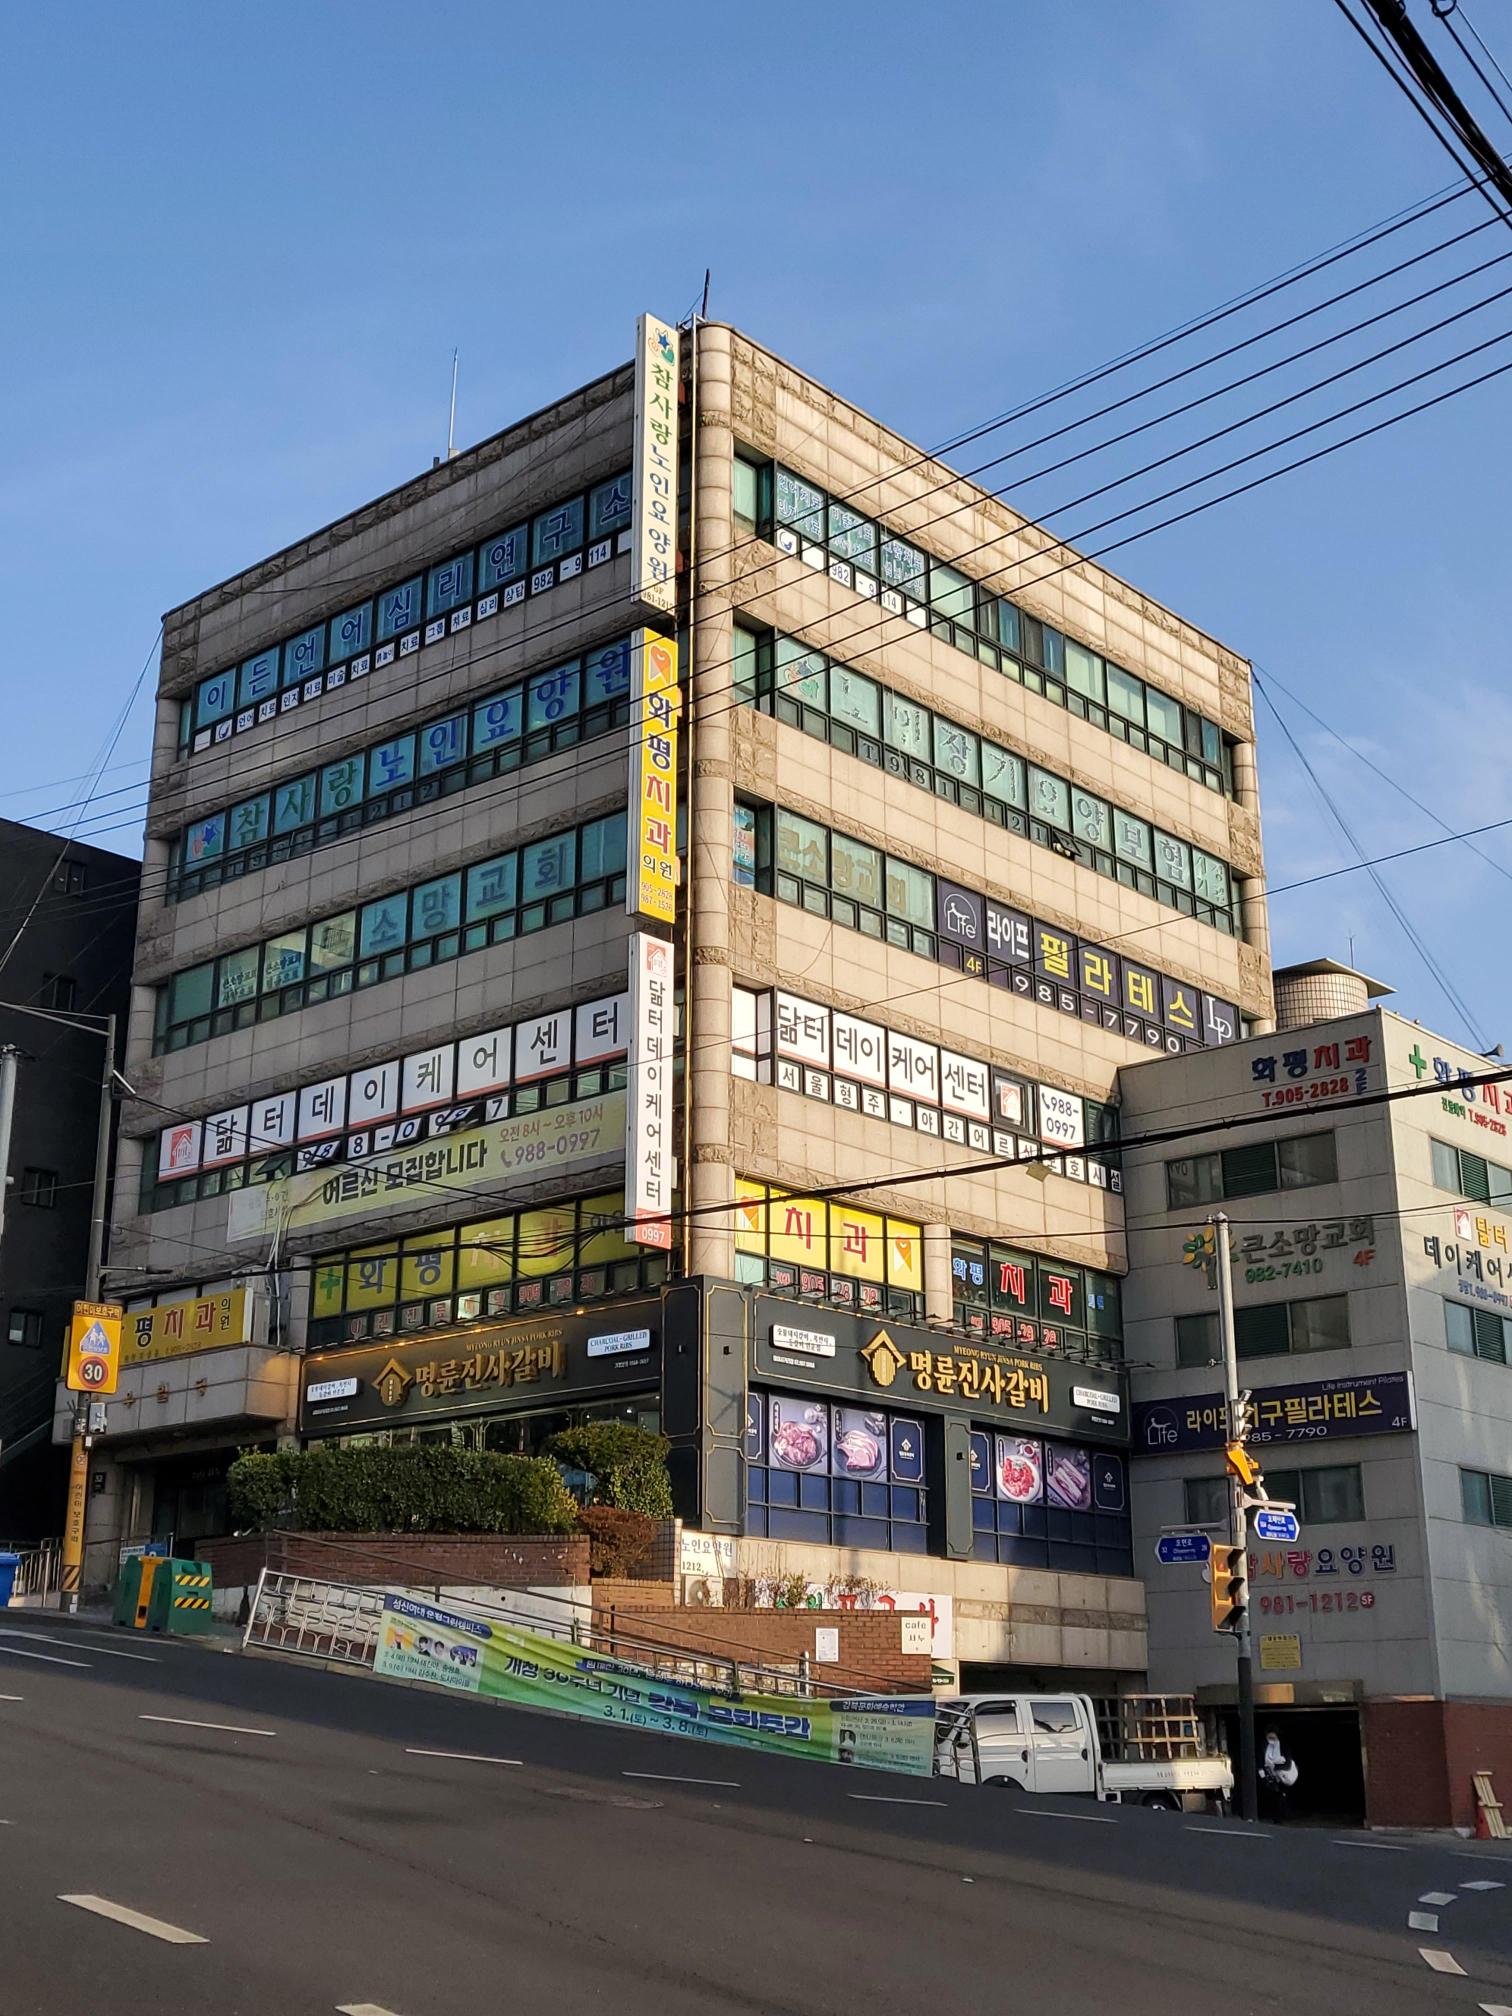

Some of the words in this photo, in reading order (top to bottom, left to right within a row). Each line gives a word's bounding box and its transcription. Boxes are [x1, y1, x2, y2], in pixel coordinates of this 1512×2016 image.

[647, 364, 673, 586] 참사랑노인요양원
[239, 700, 275, 728] 언어치료
[283, 680, 320, 708] 인지치료
[329, 659, 368, 686] 미술치료
[534, 545, 607, 591] 982-9114
[646, 690, 672, 855] 화평치과
[643, 854, 672, 881] 의원
[370, 842, 567, 951] 소망교회
[966, 958, 983, 974] 4F
[988, 909, 1030, 960] 라이프
[1040, 931, 1194, 1030] 필라테스
[1014, 975, 1180, 1054] 985-7790
[777, 1002, 987, 1109] 닮터데이케어센터
[1251, 1035, 1373, 1082] 화평치과
[216, 1001, 618, 1156] 닮터데이케어센터
[645, 979, 666, 1207] 닮터데이케어센터
[782, 1067, 854, 1107] 서울형
[1262, 1077, 1349, 1107] T.905-2828
[499, 1127, 521, 1144] 오전
[522, 1121, 540, 1137] 8시
[553, 1112, 577, 1130] 오후
[579, 1103, 603, 1123] 10시
[1046, 1116, 1076, 1141] 0997
[514, 1129, 601, 1167] 988-0997
[322, 1166, 378, 1206] 어르신
[385, 1138, 489, 1191] 모집합니다
[641, 1226, 665, 1244] 0997
[785, 1206, 870, 1263] 치과
[1240, 1218, 1375, 1265] 큰소망교회
[1475, 1216, 1508, 1254] 닮터
[1245, 1258, 1323, 1284] 982-7410
[1353, 1249, 1376, 1266] 4F
[952, 1257, 984, 1286] 화평
[1000, 1262, 1073, 1316] 치과
[134, 1302, 216, 1348] 평치과
[220, 1296, 231, 1331] 의원
[84, 1363, 103, 1382] 30
[415, 1340, 561, 1398] 명륜진사갈비
[910, 1349, 1049, 1414] 명륜진사갈비
[1014, 1357, 1030, 1369] PORK
[1030, 1361, 1043, 1373] RIBS
[1391, 1416, 1408, 1428] 4F
[392, 1598, 426, 1618] 성신여대
[905, 1620, 927, 1629] cafe
[1260, 1592, 1358, 1615] 981-1212
[504, 1654, 539, 1680] 개청
[607, 1685, 642, 1705] 기념
